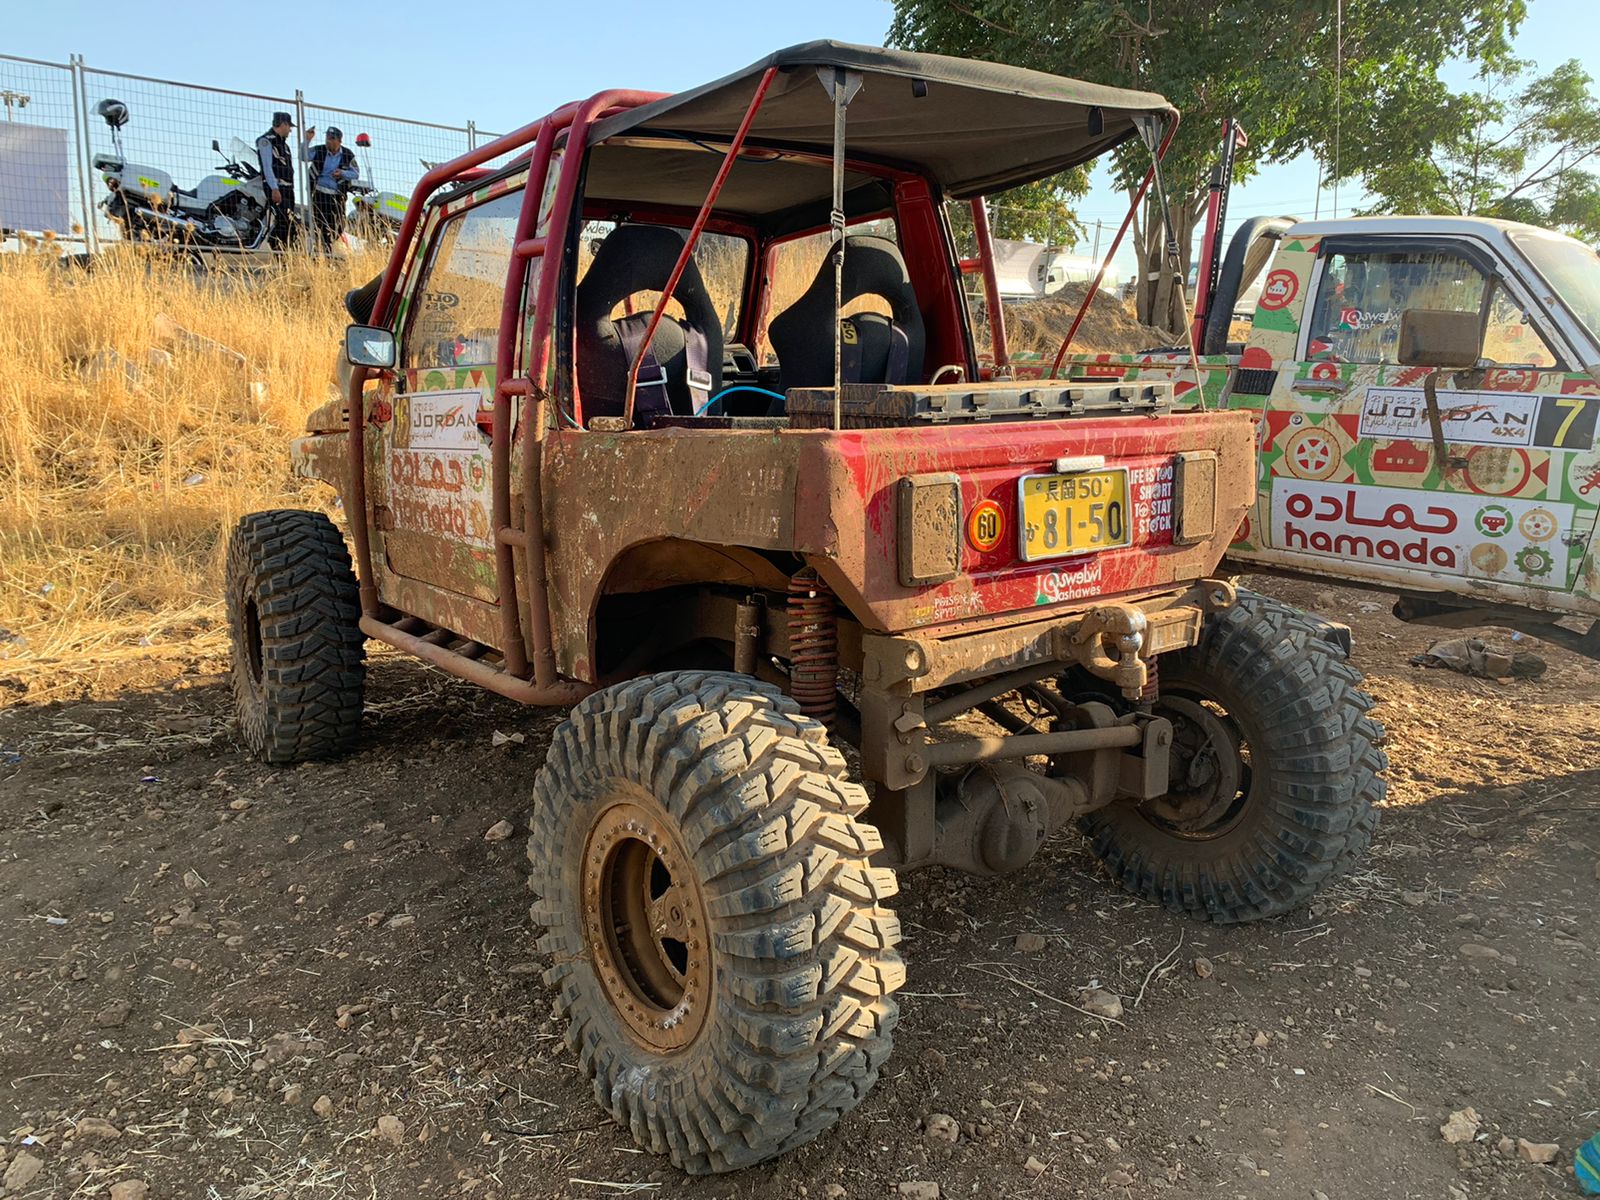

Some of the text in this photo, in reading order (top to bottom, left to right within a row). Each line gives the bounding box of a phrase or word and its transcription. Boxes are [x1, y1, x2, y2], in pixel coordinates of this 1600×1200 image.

[413, 412, 476, 428] JORDAN
[1552, 398, 1586, 447] 7
[1043, 501, 1122, 549] 81-50
[1151, 499, 1172, 516] STAY
[978, 513, 996, 540] 60
[1284, 521, 1456, 569] hamada
